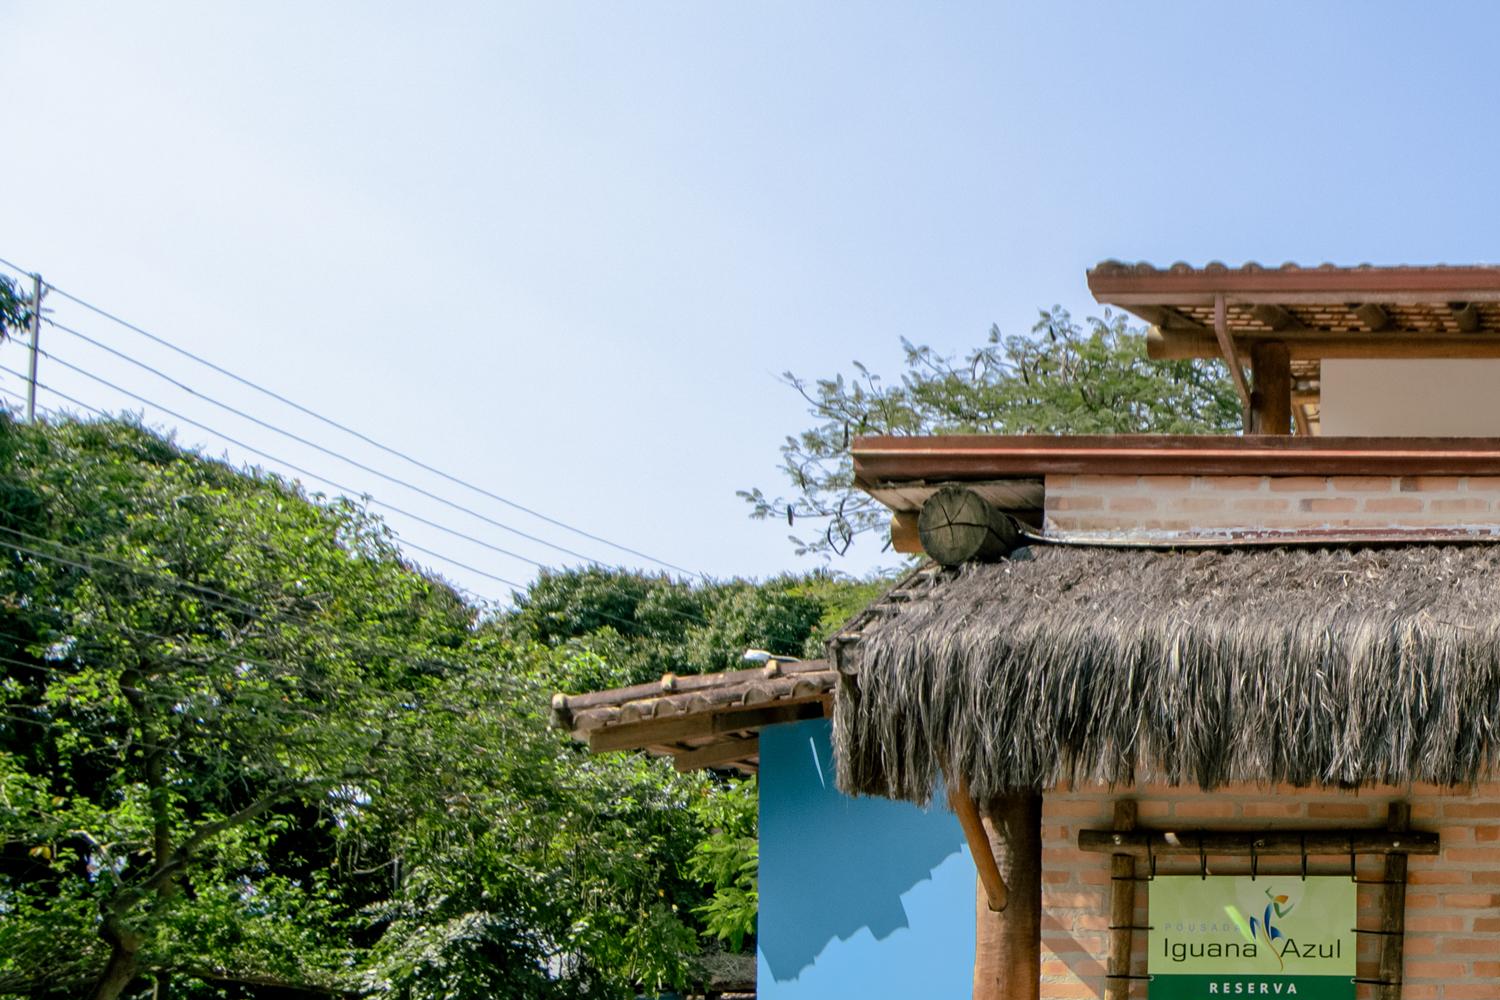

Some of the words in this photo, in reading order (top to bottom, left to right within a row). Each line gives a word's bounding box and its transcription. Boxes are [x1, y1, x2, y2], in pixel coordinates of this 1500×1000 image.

[1164, 938, 1257, 962] Iguana
[1280, 938, 1341, 959] Azul
[1209, 983, 1297, 994] RESERVA
